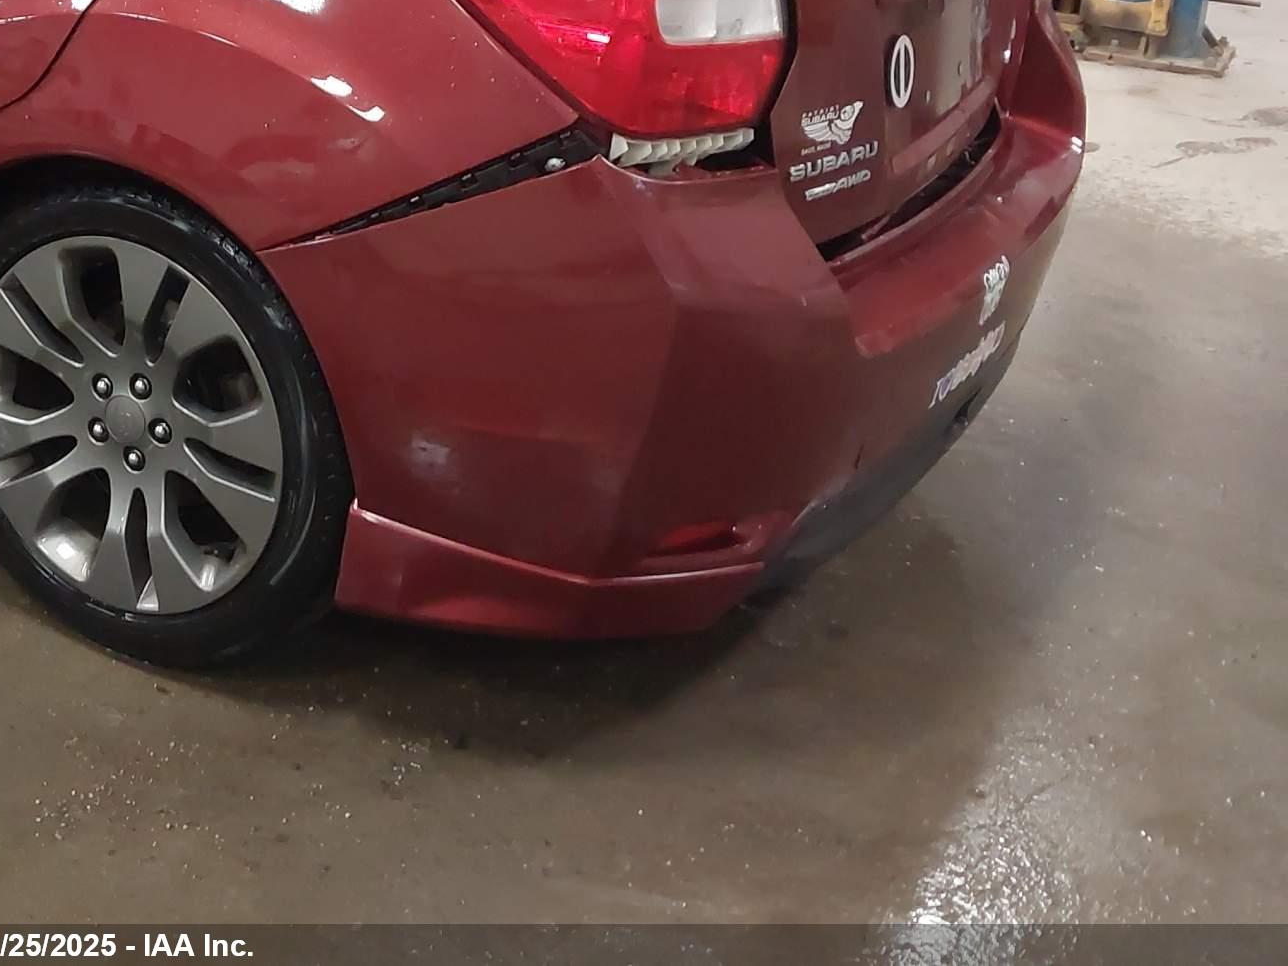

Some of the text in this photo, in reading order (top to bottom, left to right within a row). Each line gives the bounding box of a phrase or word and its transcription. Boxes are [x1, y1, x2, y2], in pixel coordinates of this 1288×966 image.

[801, 110, 840, 127] SUBARU
[789, 140, 879, 183] SUBARU
[833, 169, 871, 193] AWD
